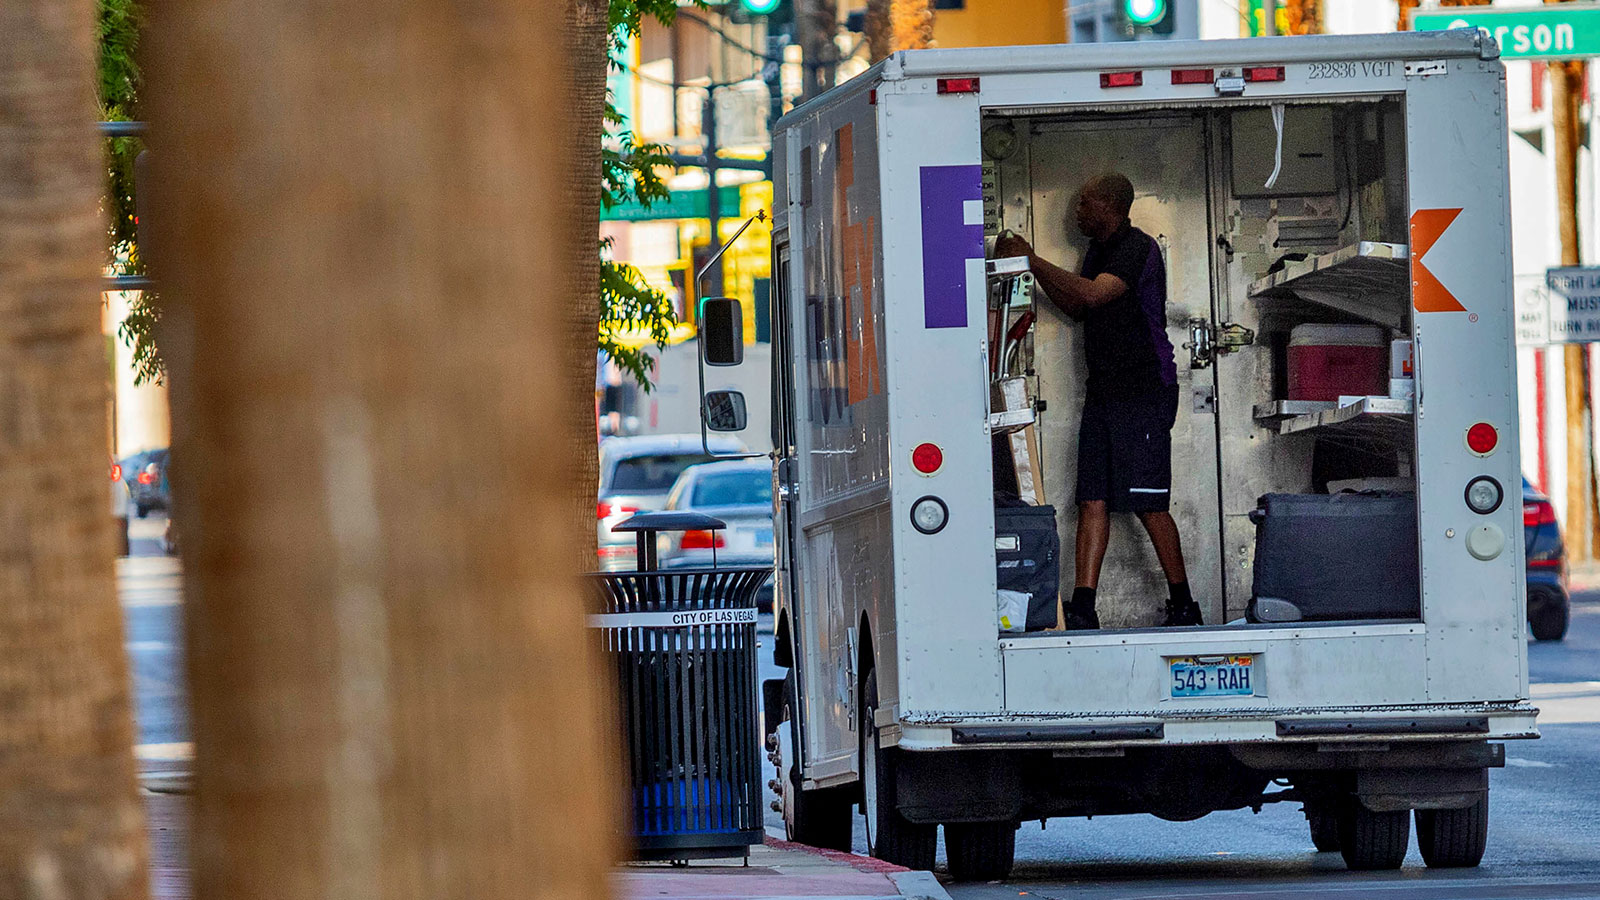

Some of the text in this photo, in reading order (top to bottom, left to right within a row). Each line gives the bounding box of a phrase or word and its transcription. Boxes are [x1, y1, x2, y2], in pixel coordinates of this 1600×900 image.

[1448, 19, 1574, 53] rson
[1308, 61, 1394, 79] 232836 VGT
[672, 610, 754, 625] CITY OF LAS VEGAS
